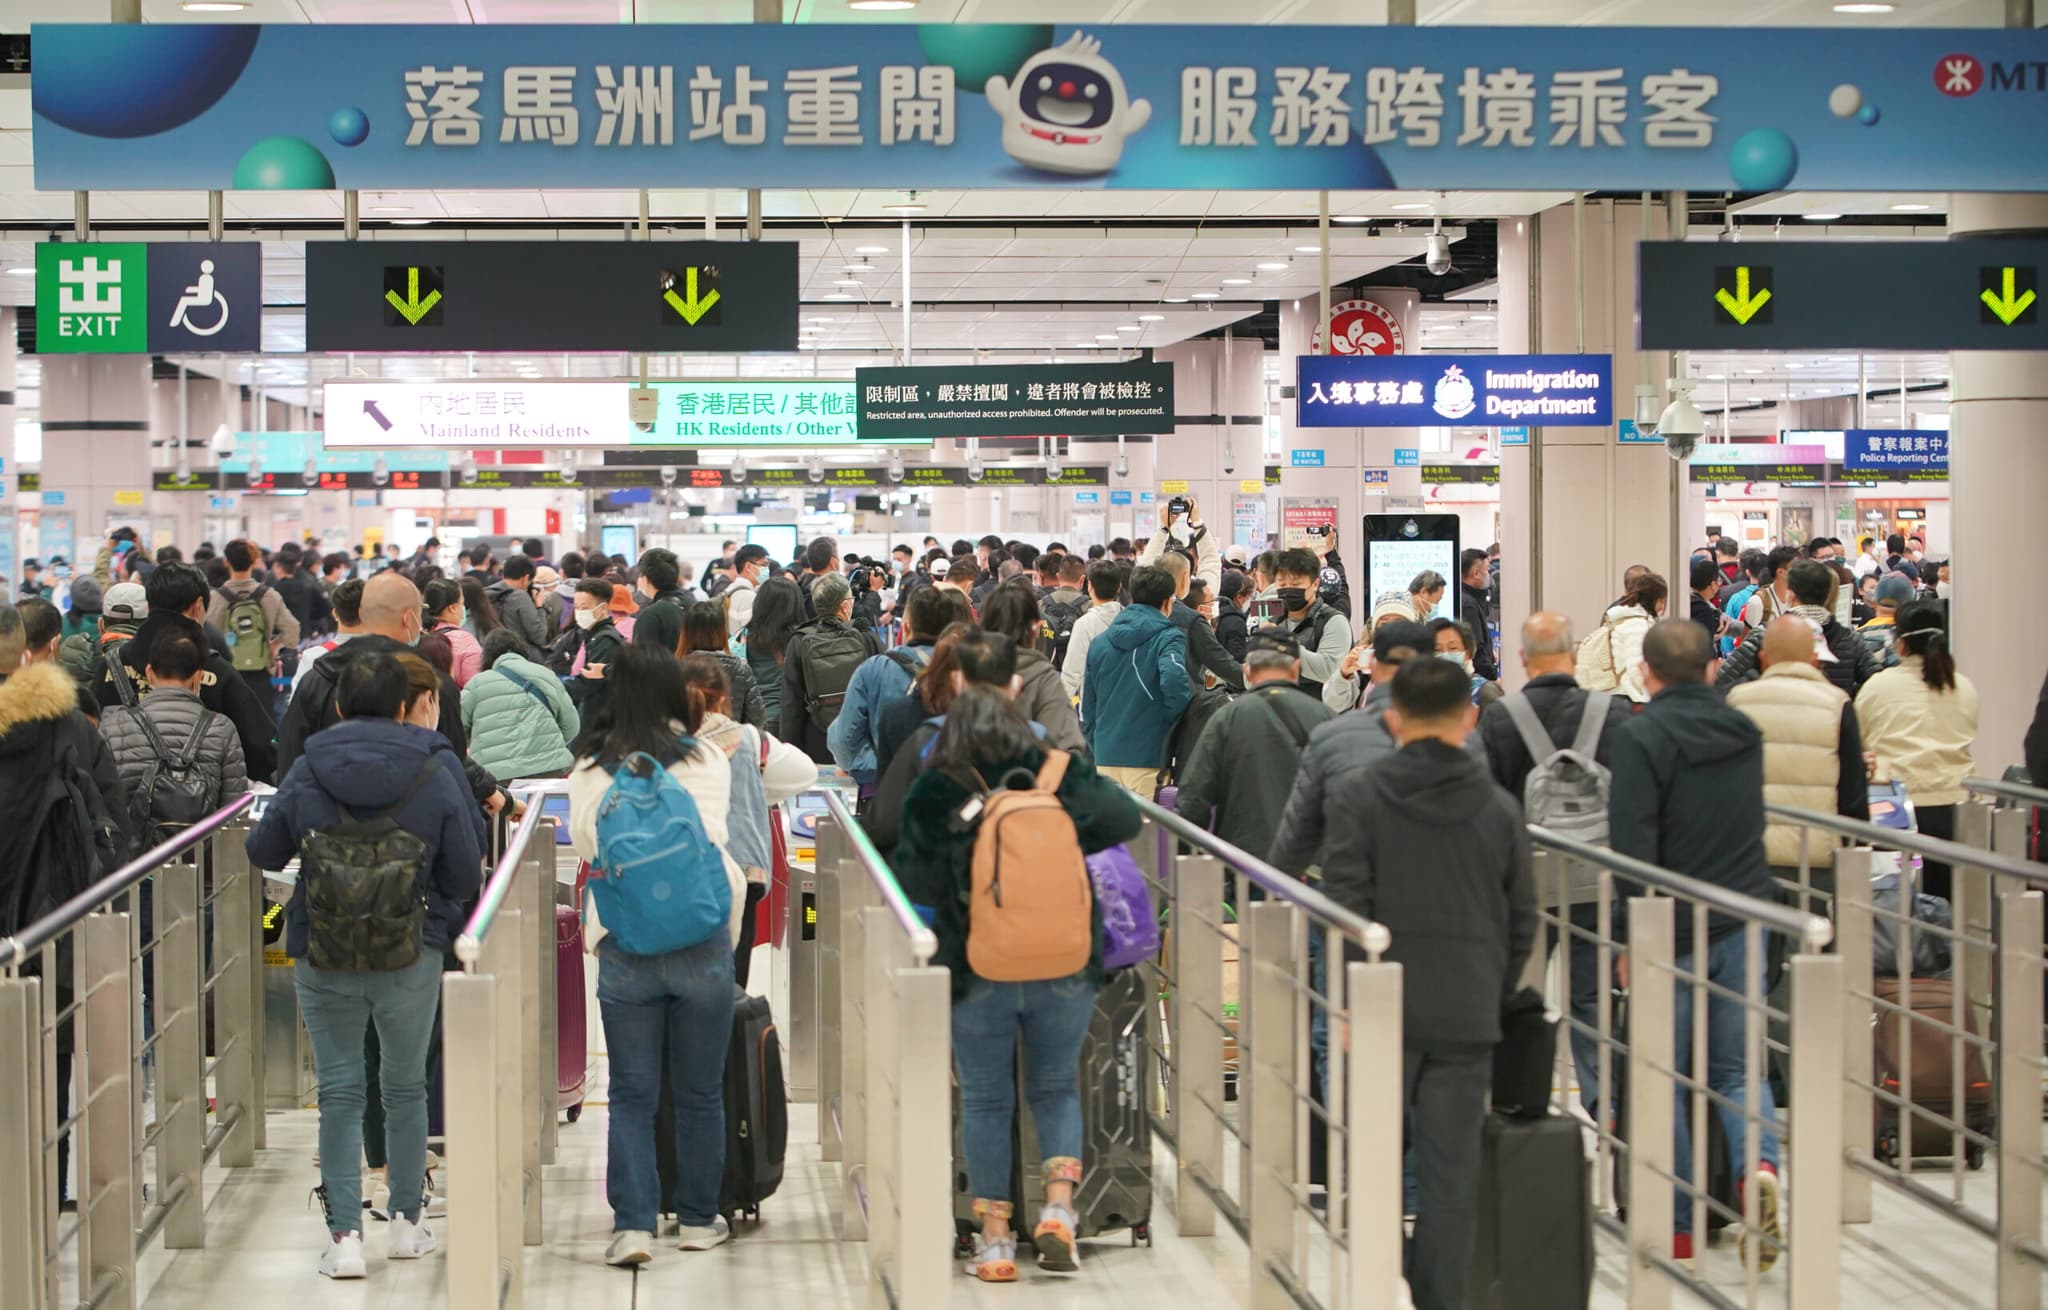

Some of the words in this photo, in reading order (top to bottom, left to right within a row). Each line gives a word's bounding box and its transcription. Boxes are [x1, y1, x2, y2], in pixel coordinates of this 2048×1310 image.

[404, 65, 956, 146] 落馬洲站重開
[1180, 66, 1720, 148] 服務跨境乘客
[59, 257, 121, 313] 出
[59, 316, 121, 337] EXIT
[1307, 380, 1425, 405] 入境事務處
[1486, 369, 1599, 393] Immigration
[420, 391, 526, 415] 內地居民
[675, 392, 776, 416] 香港居民
[866, 411, 906, 420] Restricted
[907, 412, 927, 420] area,
[928, 409, 981, 419] unauthorized
[982, 410, 1008, 418] access
[1009, 408, 1053, 419] prohibited.
[1054, 407, 1089, 417] Offender
[1090, 407, 1105, 416] will
[1106, 407, 1117, 416] be
[1118, 406, 1165, 418] prosecuted.
[1486, 395, 1597, 419] Department
[420, 423, 500, 438] Mainland
[508, 423, 591, 438] Residents
[675, 422, 704, 436] HK
[708, 421, 783, 436] Residents
[796, 421, 843, 436] Other
[1860, 452, 1886, 463] Police
[1887, 453, 1928, 464] Reporting
